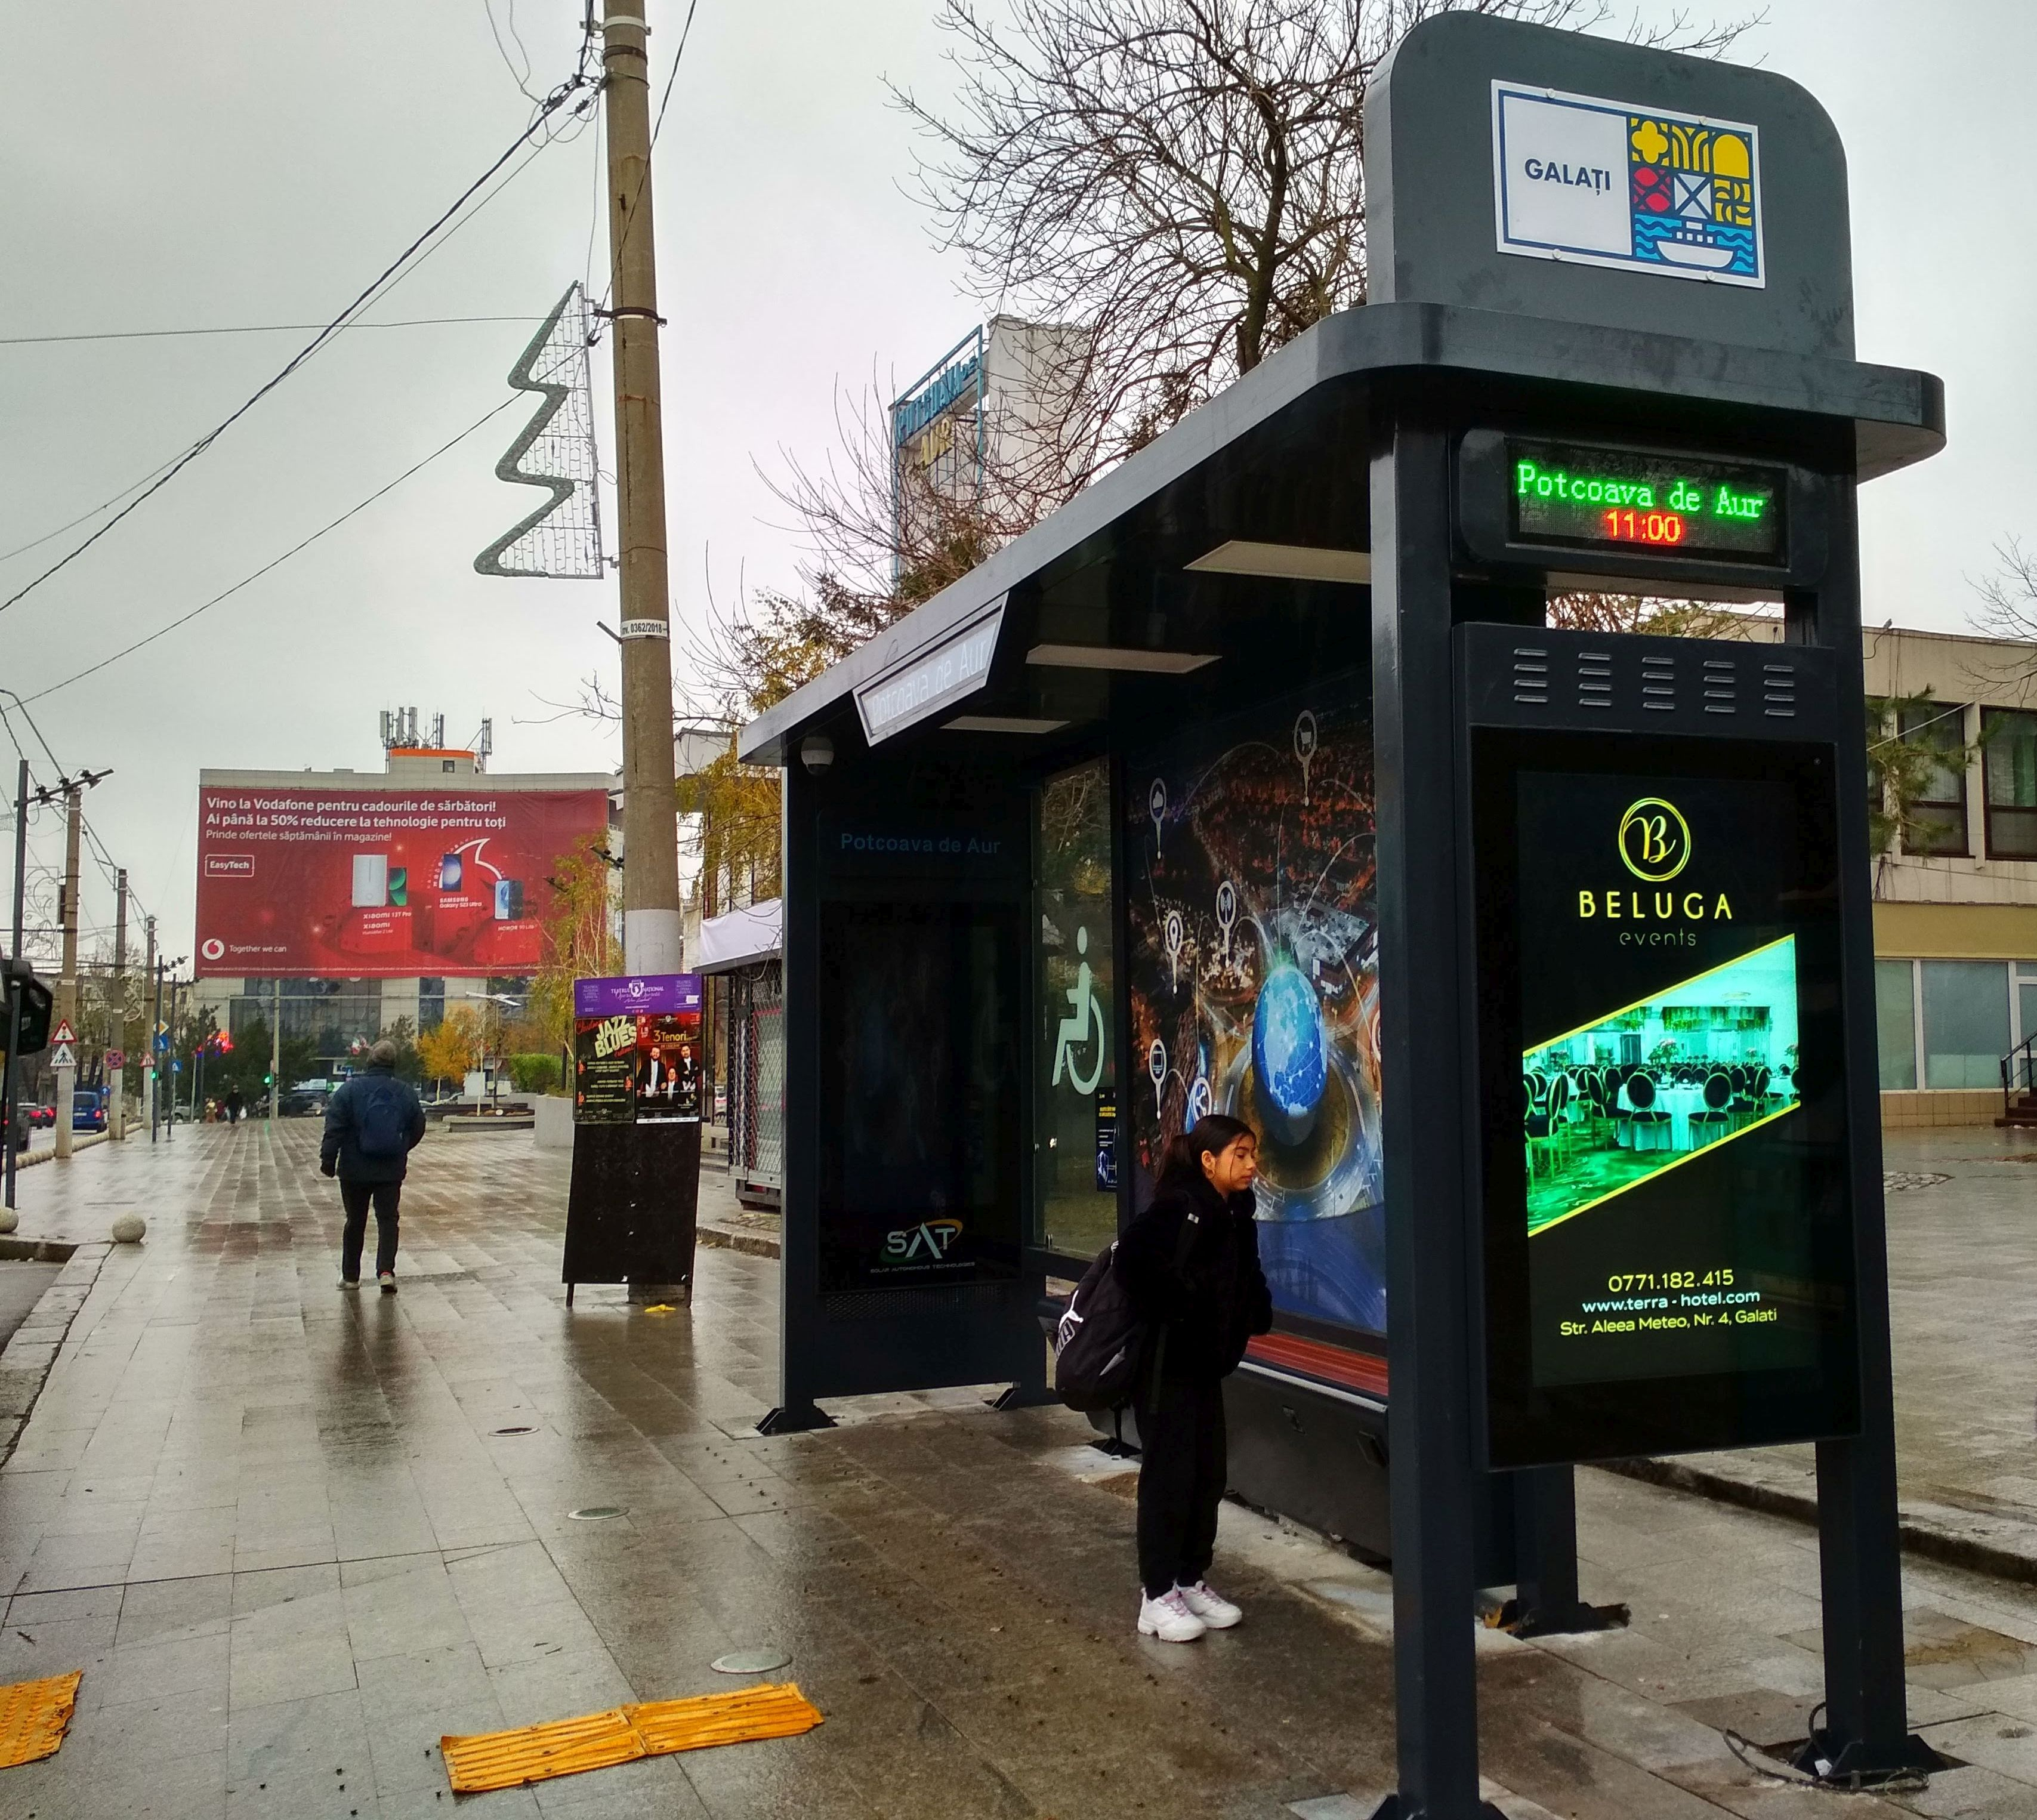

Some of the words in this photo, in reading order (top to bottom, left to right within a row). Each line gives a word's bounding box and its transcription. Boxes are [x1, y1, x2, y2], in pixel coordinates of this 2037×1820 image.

[1524, 158, 1610, 196] GALAȚI
[1518, 462, 1655, 508] Potcoava
[1669, 482, 1701, 511] de
[1715, 486, 1763, 519] Aur
[1606, 511, 1681, 542] 11:00
[631, 622, 662, 633] 0362/2018
[872, 673, 930, 728] Potcoava
[936, 660, 952, 694] de
[959, 640, 986, 682] Aur
[207, 797, 236, 809] Vino
[240, 798, 251, 809] la
[254, 798, 314, 810] Vodafone
[317, 800, 359, 813] pentru
[362, 800, 418, 812] cadourile
[420, 800, 435, 811] de
[437, 800, 496, 812] sărbători!
[206, 813, 220, 825] Ai
[222, 814, 254, 827] până
[257, 814, 268, 826] la
[270, 815, 298, 826] 50%
[301, 816, 357, 827] reducere
[360, 816, 371, 827] la
[374, 816, 439, 829] tehnologie
[441, 818, 482, 829] pentru
[206, 830, 237, 839] Prinde
[239, 831, 277, 840] ofertele
[279, 831, 331, 842] săptămânii
[333, 832, 342, 841] în
[344, 832, 391, 843] magazine!
[840, 833, 933, 852] Potcoava
[939, 837, 961, 852] de
[967, 837, 1001, 854] Aur
[210, 861, 249, 870] EasyTech
[1579, 890, 1732, 919] BELUGA
[1619, 927, 1696, 946] events
[230, 945, 260, 954] Together
[596, 1015, 630, 1040] JAZZ
[653, 1030, 661, 1042] 3
[661, 1030, 687, 1042] Tenori
[595, 1026, 637, 1058] BLUES
[887, 1222, 955, 1259] SAT
[1608, 1269, 1734, 1292] 0771.182.415
[1560, 1321, 1588, 1336] Str.
[1591, 1318, 1635, 1334] Aleea
[1638, 1315, 1690, 1331] Meteo,
[1694, 1313, 1715, 1327] Nr.
[1718, 1312, 1732, 1326] 4,
[1734, 1307, 1777, 1324] Galati
